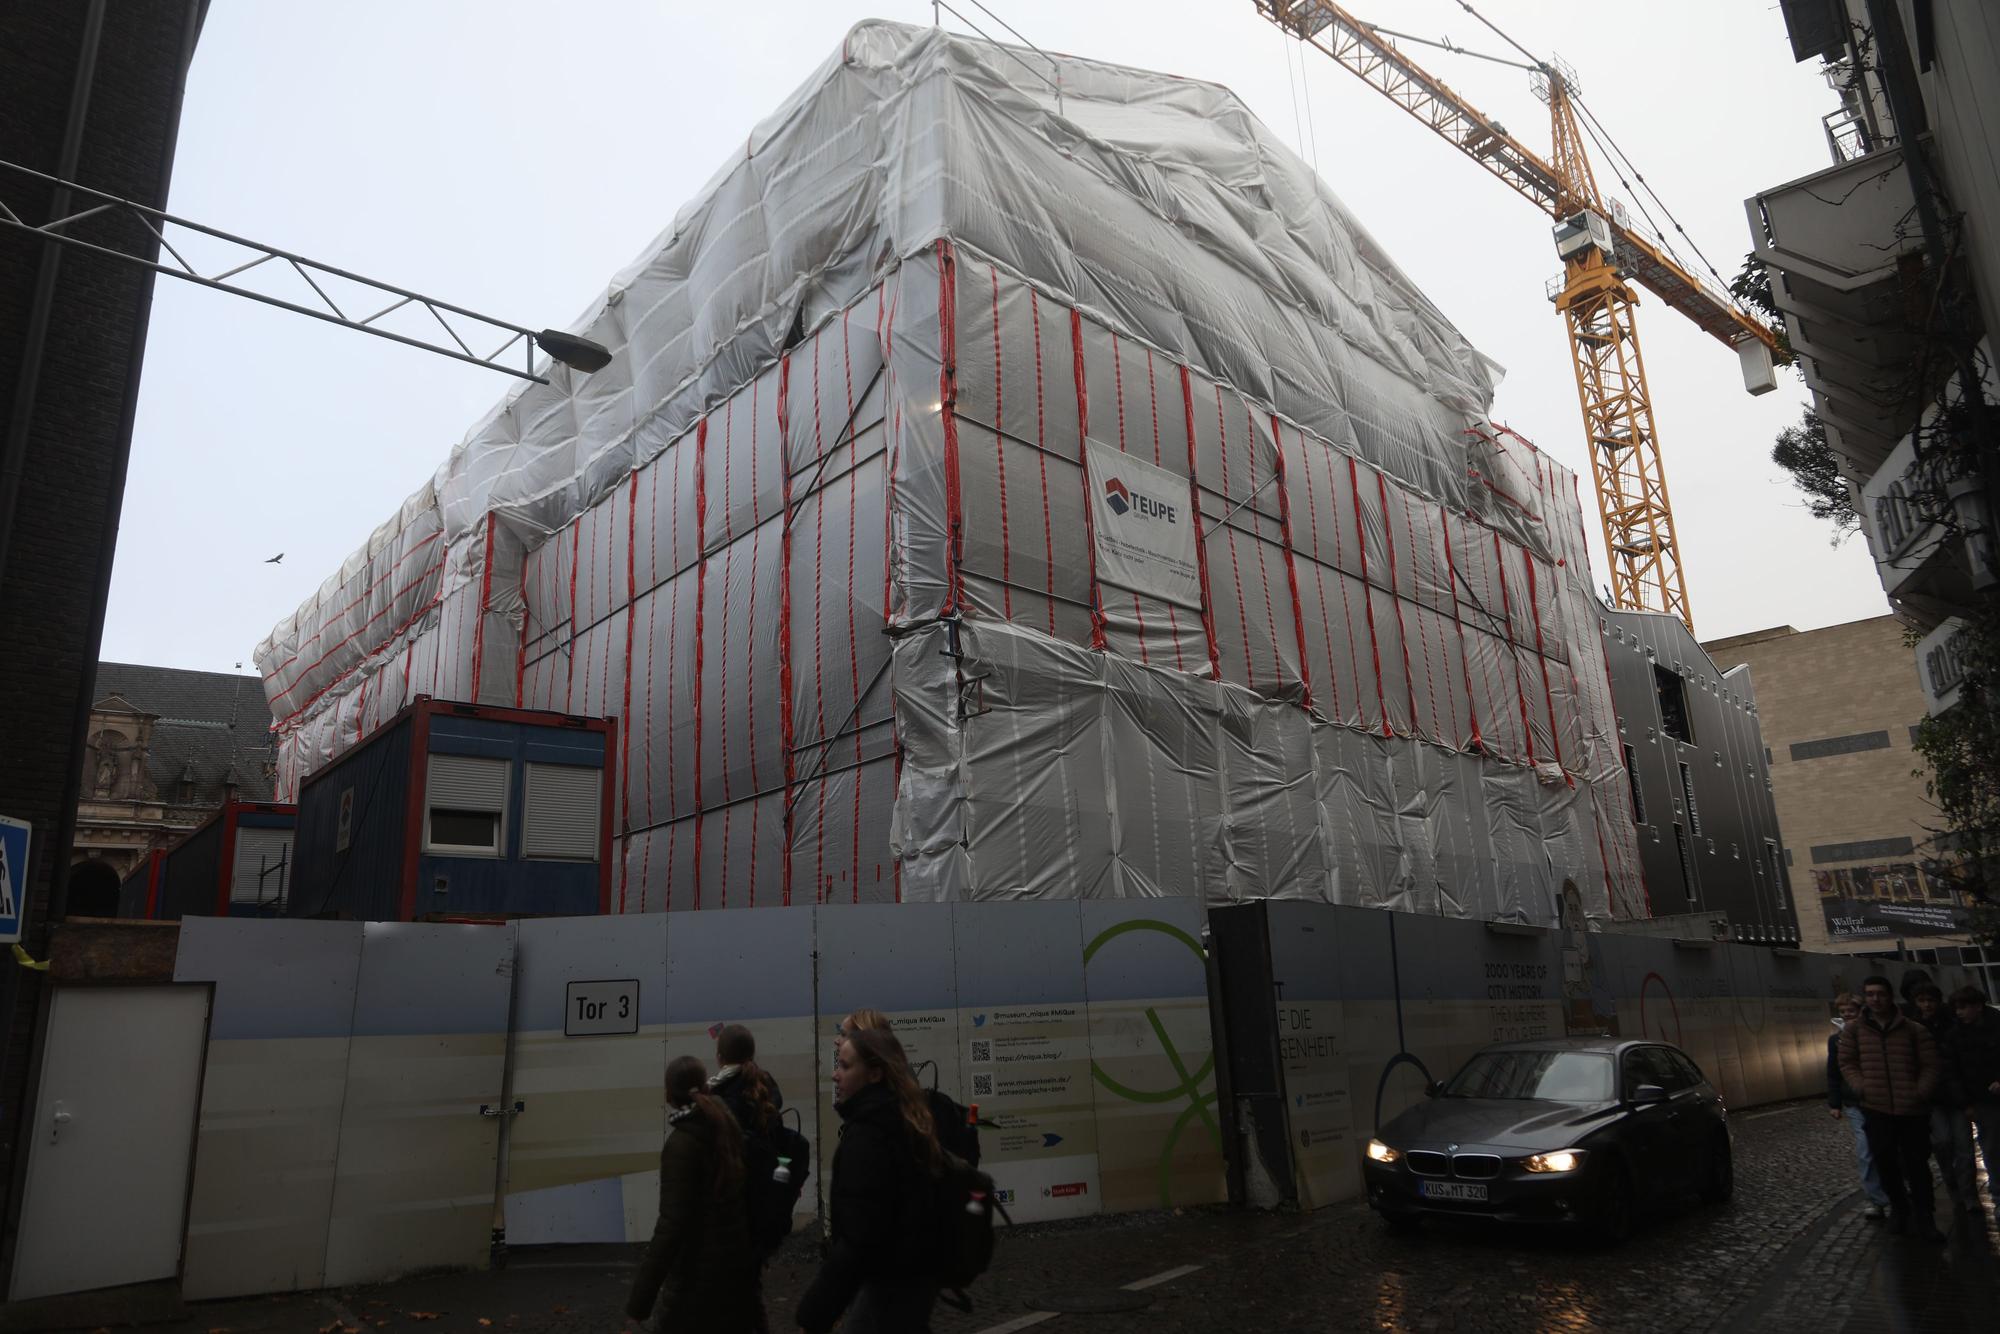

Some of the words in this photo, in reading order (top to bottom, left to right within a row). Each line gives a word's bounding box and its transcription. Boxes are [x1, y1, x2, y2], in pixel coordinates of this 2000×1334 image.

[1130, 491, 1176, 525] TEUPE
[1832, 915, 1865, 927] Wallraf
[1833, 925, 1849, 935] das
[1850, 924, 1889, 934] Museum
[1484, 962, 1509, 978] 2000
[1510, 963, 1536, 980] YEARS
[1536, 964, 1547, 980] OF
[1487, 984, 1506, 1000] CITY
[576, 996, 608, 1021] Tor
[618, 995, 630, 1019] 3
[1289, 1008, 1312, 1030] DIE
[1280, 1036, 1340, 1060] GENHEIT.
[1425, 1183, 1444, 1196] KUS
[1450, 1185, 1465, 1198] MT
[1466, 1185, 1488, 1199] 320
